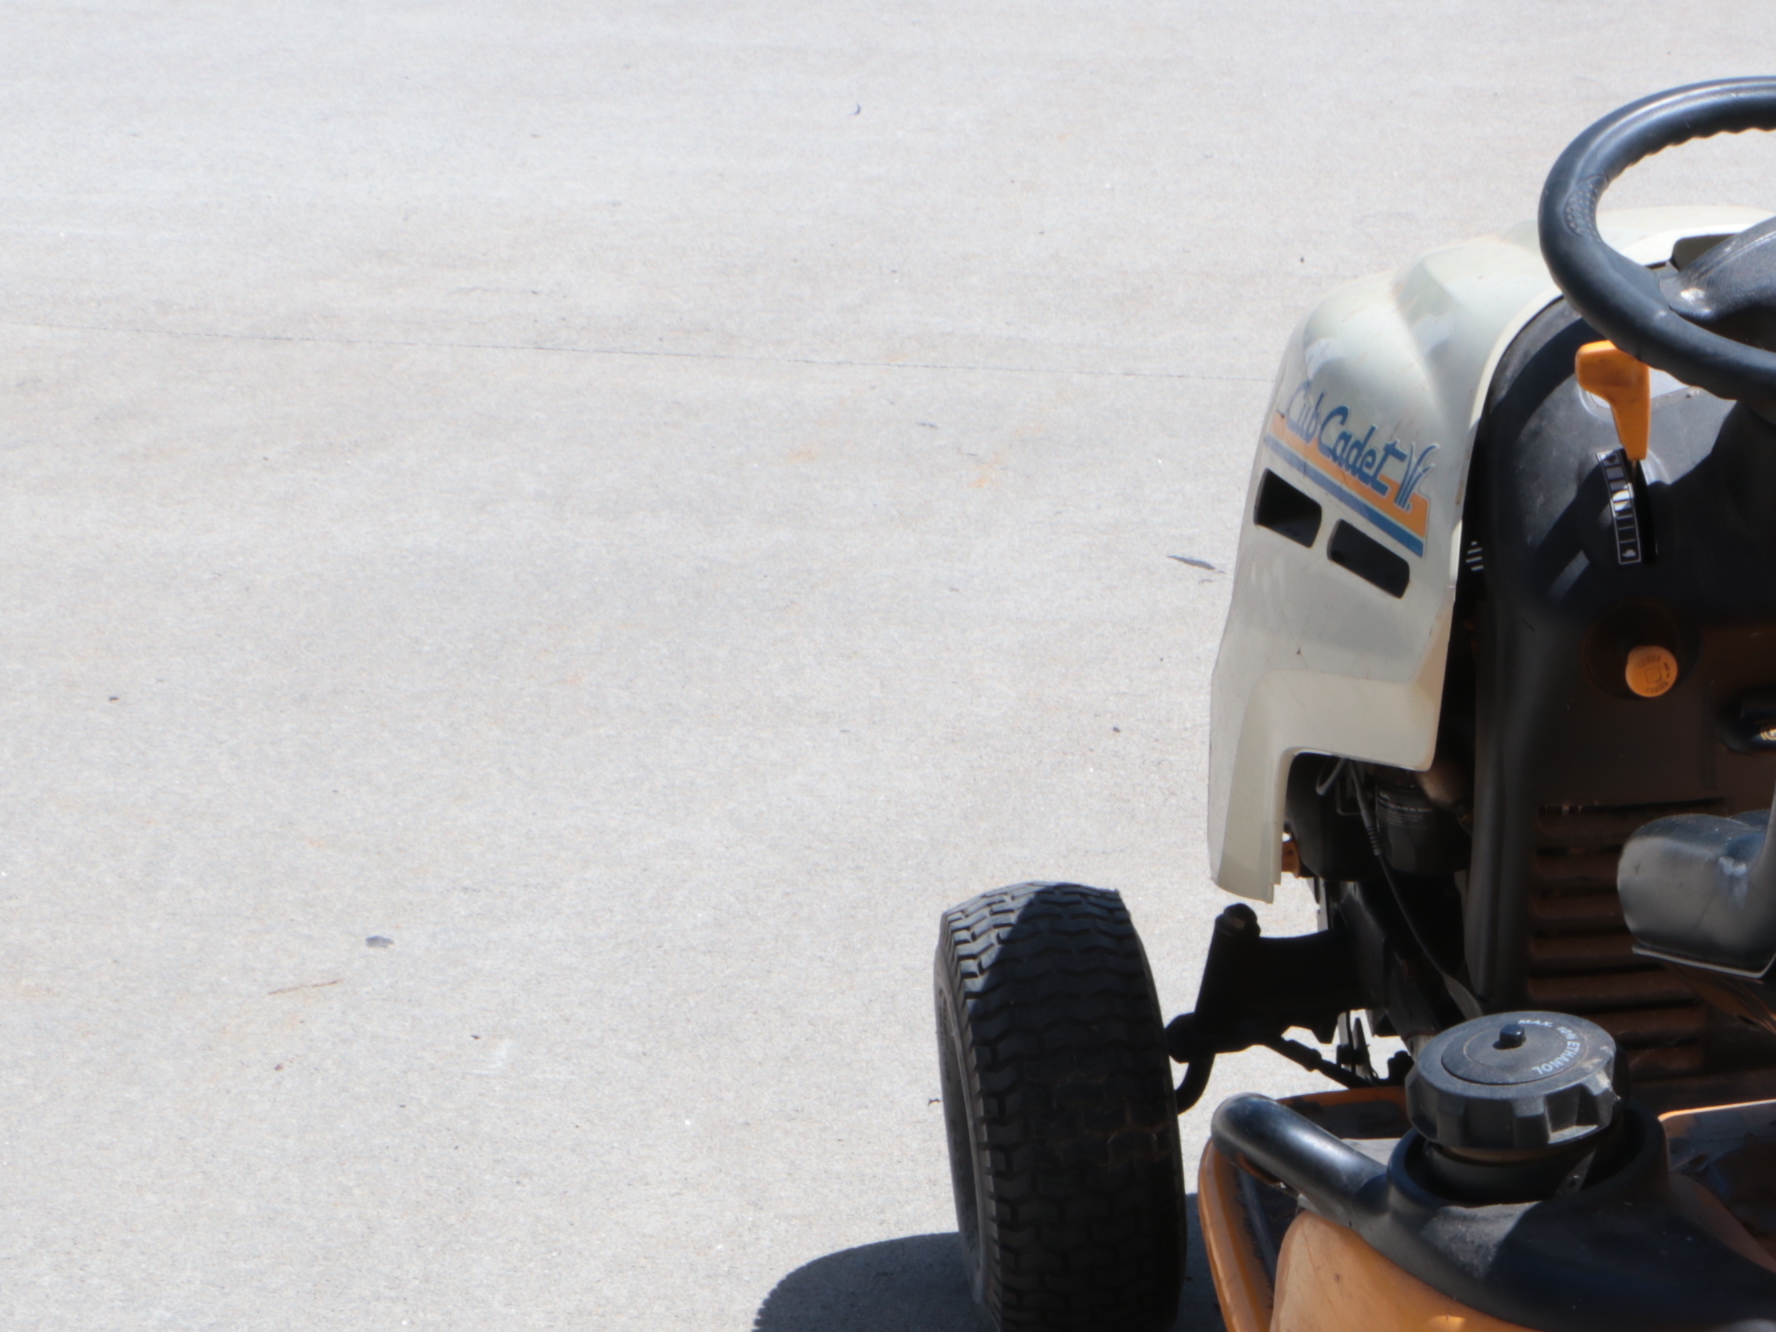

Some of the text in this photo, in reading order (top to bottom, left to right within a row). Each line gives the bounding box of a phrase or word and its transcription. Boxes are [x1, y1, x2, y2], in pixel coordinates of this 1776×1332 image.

[1286, 381, 1408, 497] Cub Cadet
[1531, 1040, 1581, 1075] ETHANOL
